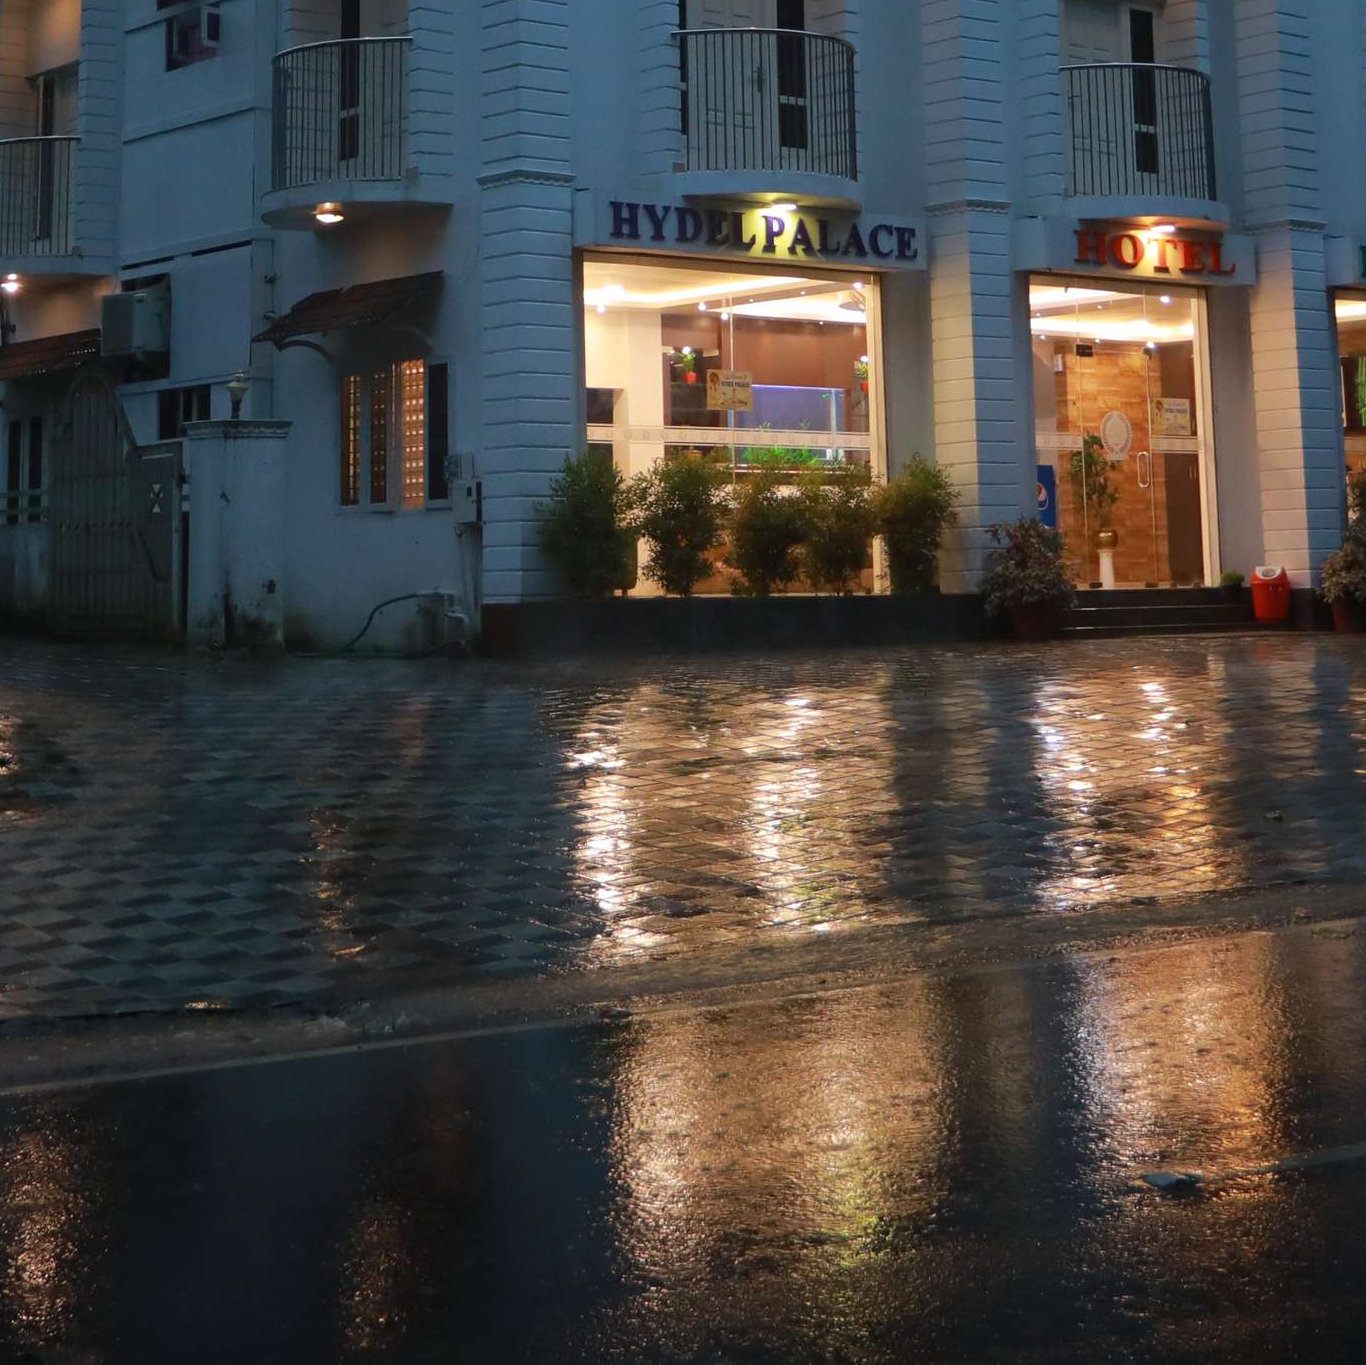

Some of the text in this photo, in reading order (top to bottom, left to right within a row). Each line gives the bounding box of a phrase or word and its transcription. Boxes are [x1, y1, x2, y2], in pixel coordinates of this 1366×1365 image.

[610, 201, 918, 259] HYDEL PALACE
[1074, 230, 1236, 275] HOTEL
